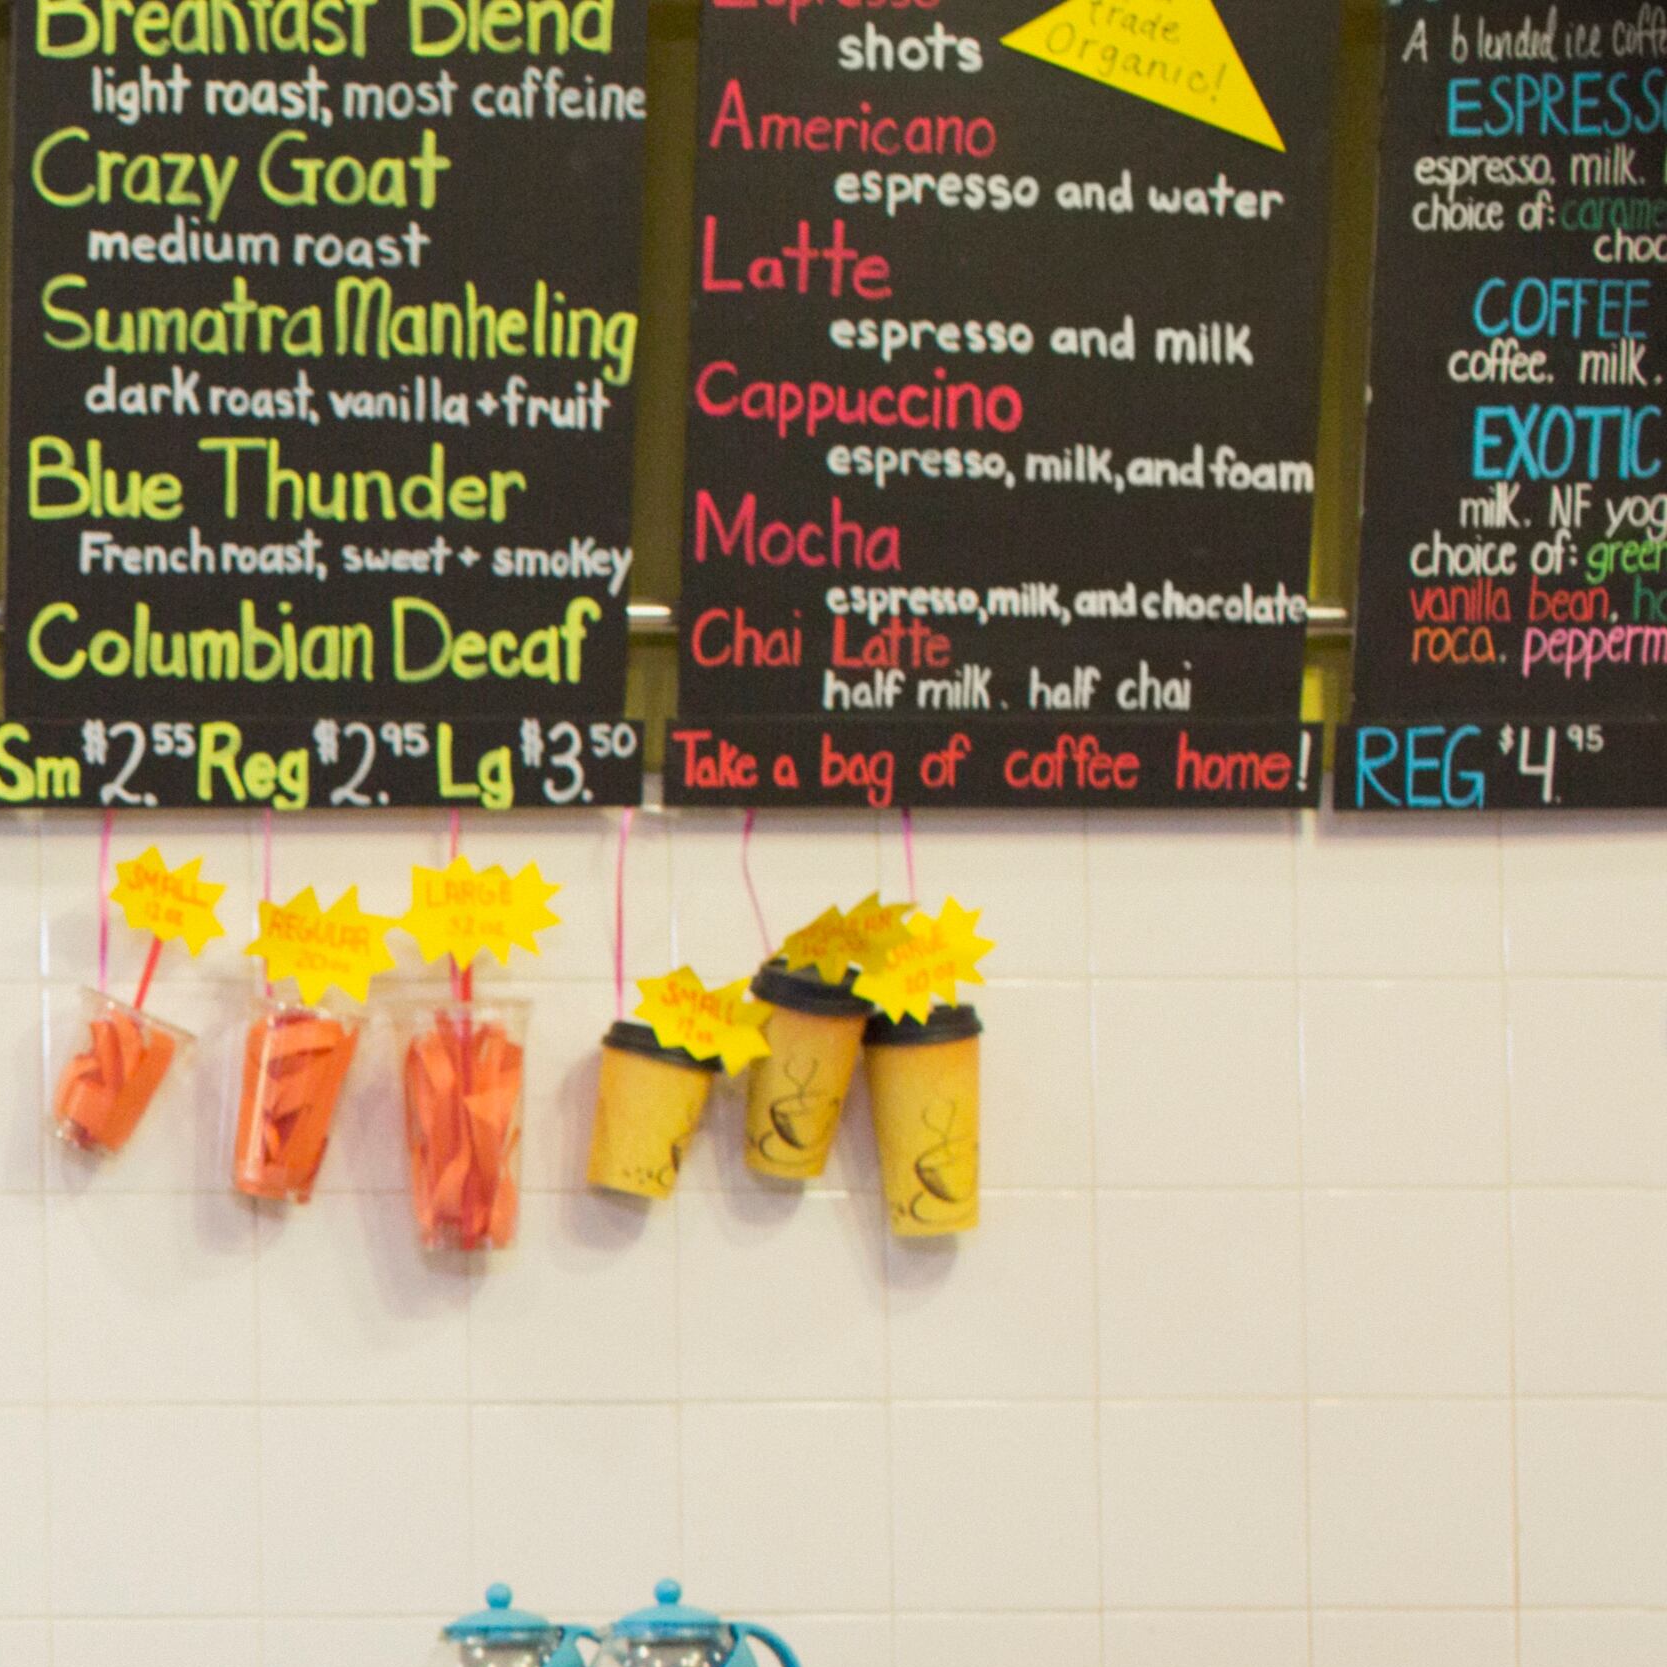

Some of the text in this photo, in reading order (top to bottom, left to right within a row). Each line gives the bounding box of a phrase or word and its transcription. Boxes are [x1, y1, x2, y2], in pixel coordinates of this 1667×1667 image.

[838, 21, 984, 73] shots
[91, 62, 648, 125] light most caffeine
[709, 78, 997, 159] Americano
[31, 125, 452, 225] Crazy Goat
[834, 169, 1285, 220] espresso and water
[1411, 190, 1504, 232] choice
[87, 214, 431, 269] medium roast
[701, 214, 893, 300] Latte
[41, 273, 639, 389] Sumatra Manheling
[1472, 277, 1650, 342] COFFEE
[694, 360, 1024, 438] Cappuccino
[28, 435, 527, 523] Blue Thunder
[1472, 403, 1661, 480] EXOTIC
[694, 489, 901, 571] Mocha
[27, 596, 602, 684] Columbian Decaf
[691, 607, 951, 670] Chai Latte
[197, 720, 310, 812] Reg
[435, 721, 515, 813] Lg
[671, 729, 1312, 812] Take a bag of coffee home!
[1356, 724, 1485, 809] REG
